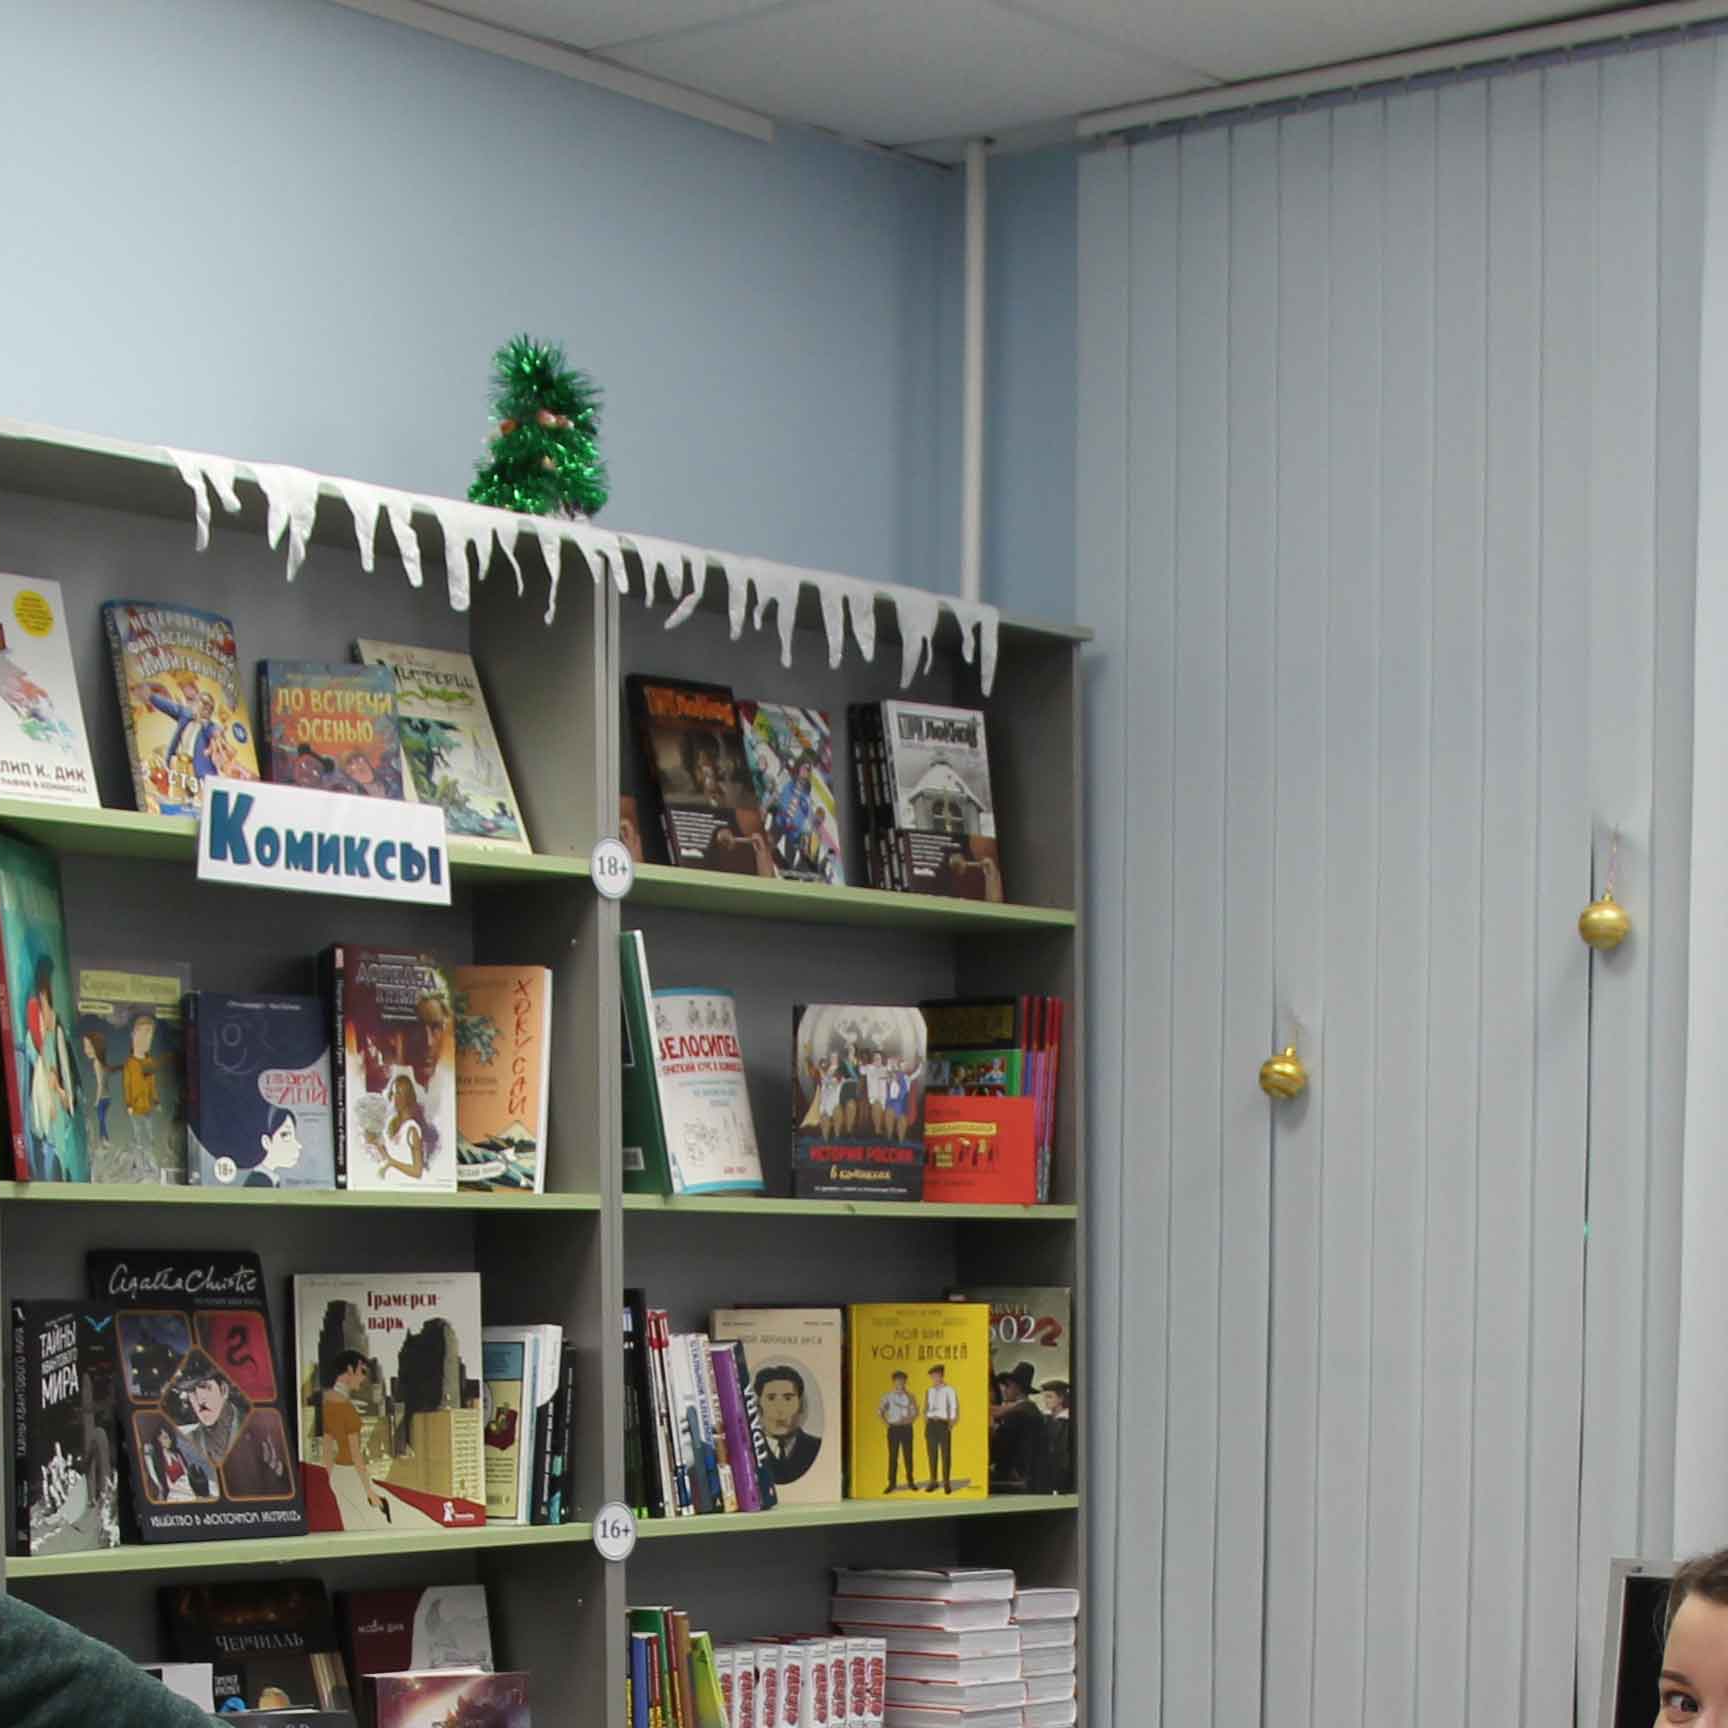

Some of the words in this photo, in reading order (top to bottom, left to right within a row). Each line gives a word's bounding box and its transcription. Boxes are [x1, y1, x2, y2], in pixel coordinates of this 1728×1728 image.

[310, 689, 393, 715] ВСТРЕЧИ
[296, 718, 375, 744] ОСЕНЬЮ
[55, 766, 87, 782] ДИК
[595, 854, 629, 876] 18+
[108, 1262, 184, 1299] Agatha
[184, 1264, 257, 1295] Christie
[367, 1315, 405, 1333] парк
[39, 1320, 77, 1359] ТАЙНЫ
[41, 1363, 79, 1409] МИРА
[743, 1383, 769, 1468] ТРАВА
[599, 1518, 632, 1540] 16+
[214, 1631, 305, 1653] ЧЕРЧИЛЛЬ
